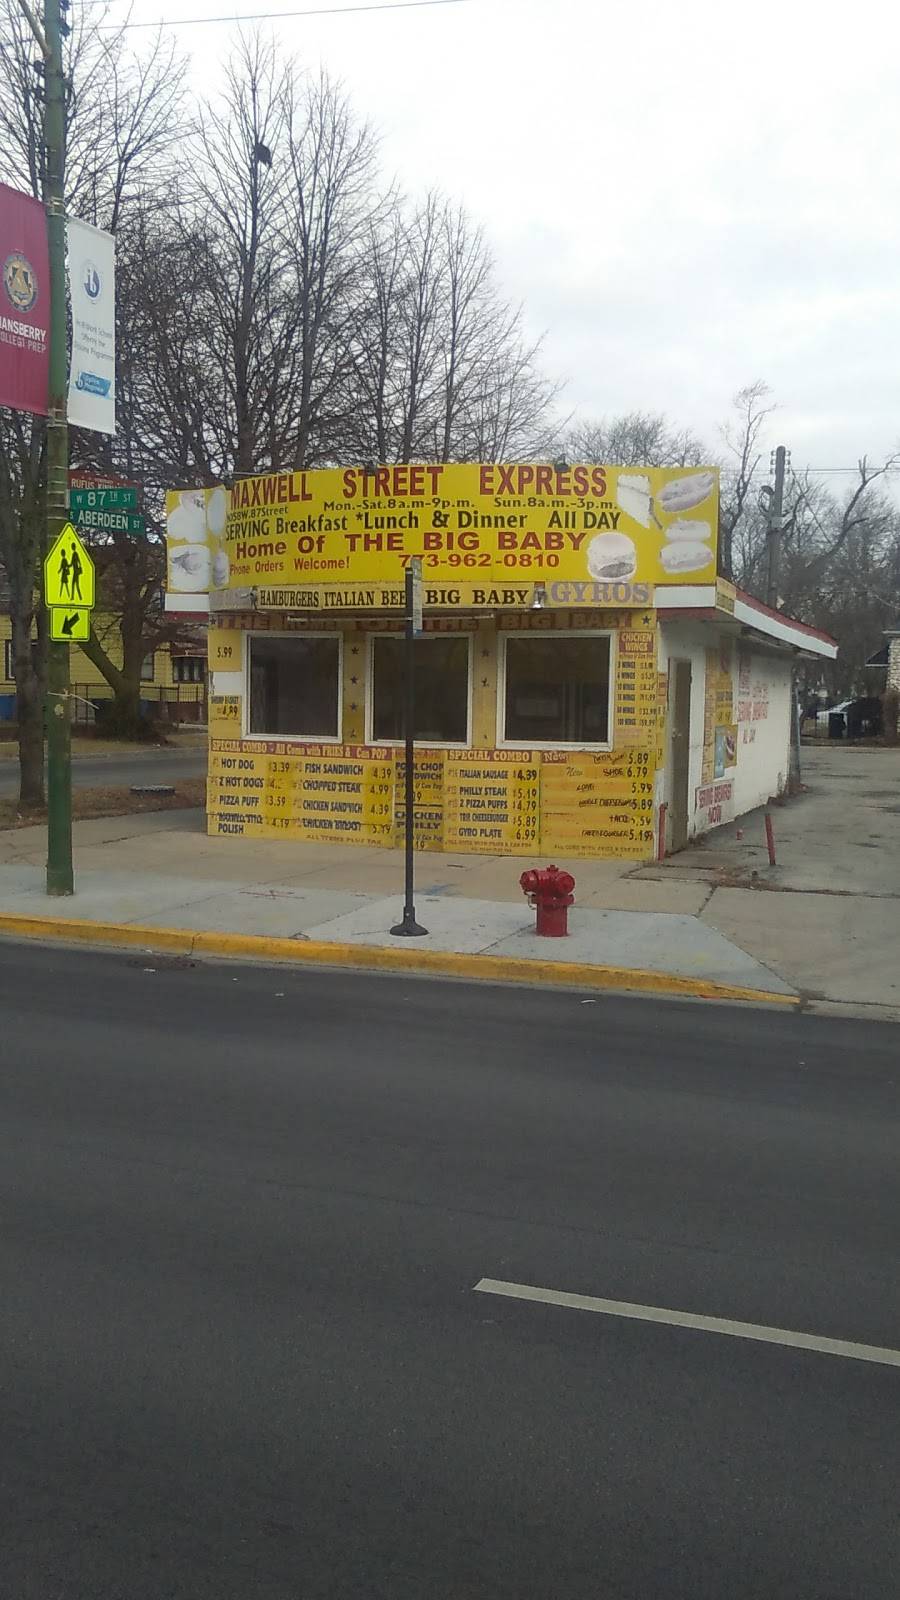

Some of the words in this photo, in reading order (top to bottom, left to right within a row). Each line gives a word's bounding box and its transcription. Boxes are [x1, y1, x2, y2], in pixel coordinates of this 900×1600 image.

[27, 340, 46, 354] PREP
[71, 478, 95, 490] RUFUS
[230, 472, 312, 510] MAXWELL
[343, 466, 444, 498] STREET
[479, 465, 607, 497] EXPRESS
[76, 495, 83, 504] W
[123, 493, 131, 503] ST
[78, 510, 129, 530] ABERDEEN
[133, 520, 140, 529] ST
[225, 518, 269, 541] SERVING
[276, 514, 347, 534] Breakfast
[431, 510, 449, 528] &
[457, 510, 527, 529] Dinner
[583, 511, 621, 530] DAY
[236, 540, 287, 559] Home
[297, 535, 326, 554] Of
[344, 532, 404, 552] THE
[423, 532, 480, 551] BIG
[498, 532, 586, 551] BABY
[255, 560, 284, 573] Orders
[294, 556, 350, 571] Welcome!
[260, 589, 319, 607] HAMBURGERS
[323, 591, 375, 607] ITALIAN
[381, 590, 408, 606] BEE
[425, 589, 461, 605] BIG
[472, 589, 529, 605] BABY
[551, 582, 649, 603] GYROS
[621, 633, 651, 642] CHICKEN
[217, 647, 233, 658] 5.99
[625, 642, 648, 652] WINGS
[212, 740, 241, 753] SPECIAL
[242, 741, 268, 753] COMBO
[448, 750, 490, 760] SPECIAL
[493, 751, 530, 762] COMBO
[628, 753, 649, 765] 5.89
[221, 757, 236, 769] HOT
[238, 759, 255, 770] DOG
[304, 763, 322, 774] FISH
[323, 764, 364, 776] SANDWICH
[420, 762, 444, 772] CHOP
[459, 769, 481, 778] ITALIAN
[482, 770, 508, 779] SAUSAGE
[627, 767, 648, 778] 6.79
[225, 777, 242, 787] HOT
[243, 778, 264, 788] DOGS
[302, 780, 337, 792] CHOPPED
[338, 782, 361, 793] STEAK
[370, 785, 389, 795] 4.99
[459, 786, 483, 796] PHILLY
[484, 787, 507, 796] STEAK
[219, 795, 240, 806] PIZZA
[242, 797, 260, 807] PUFF
[459, 799, 464, 808] 2
[466, 799, 486, 809] PIZZA
[487, 800, 508, 809] PUFFS
[302, 800, 329, 811] CHICKEN
[330, 802, 363, 814] SANDWICH
[370, 804, 389, 815] 4.39
[218, 823, 244, 833] POLISH
[302, 818, 333, 830] CHICKEN
[458, 828, 478, 837] GYRO
[479, 829, 502, 838] PLATE
[516, 829, 536, 840] 6.99
